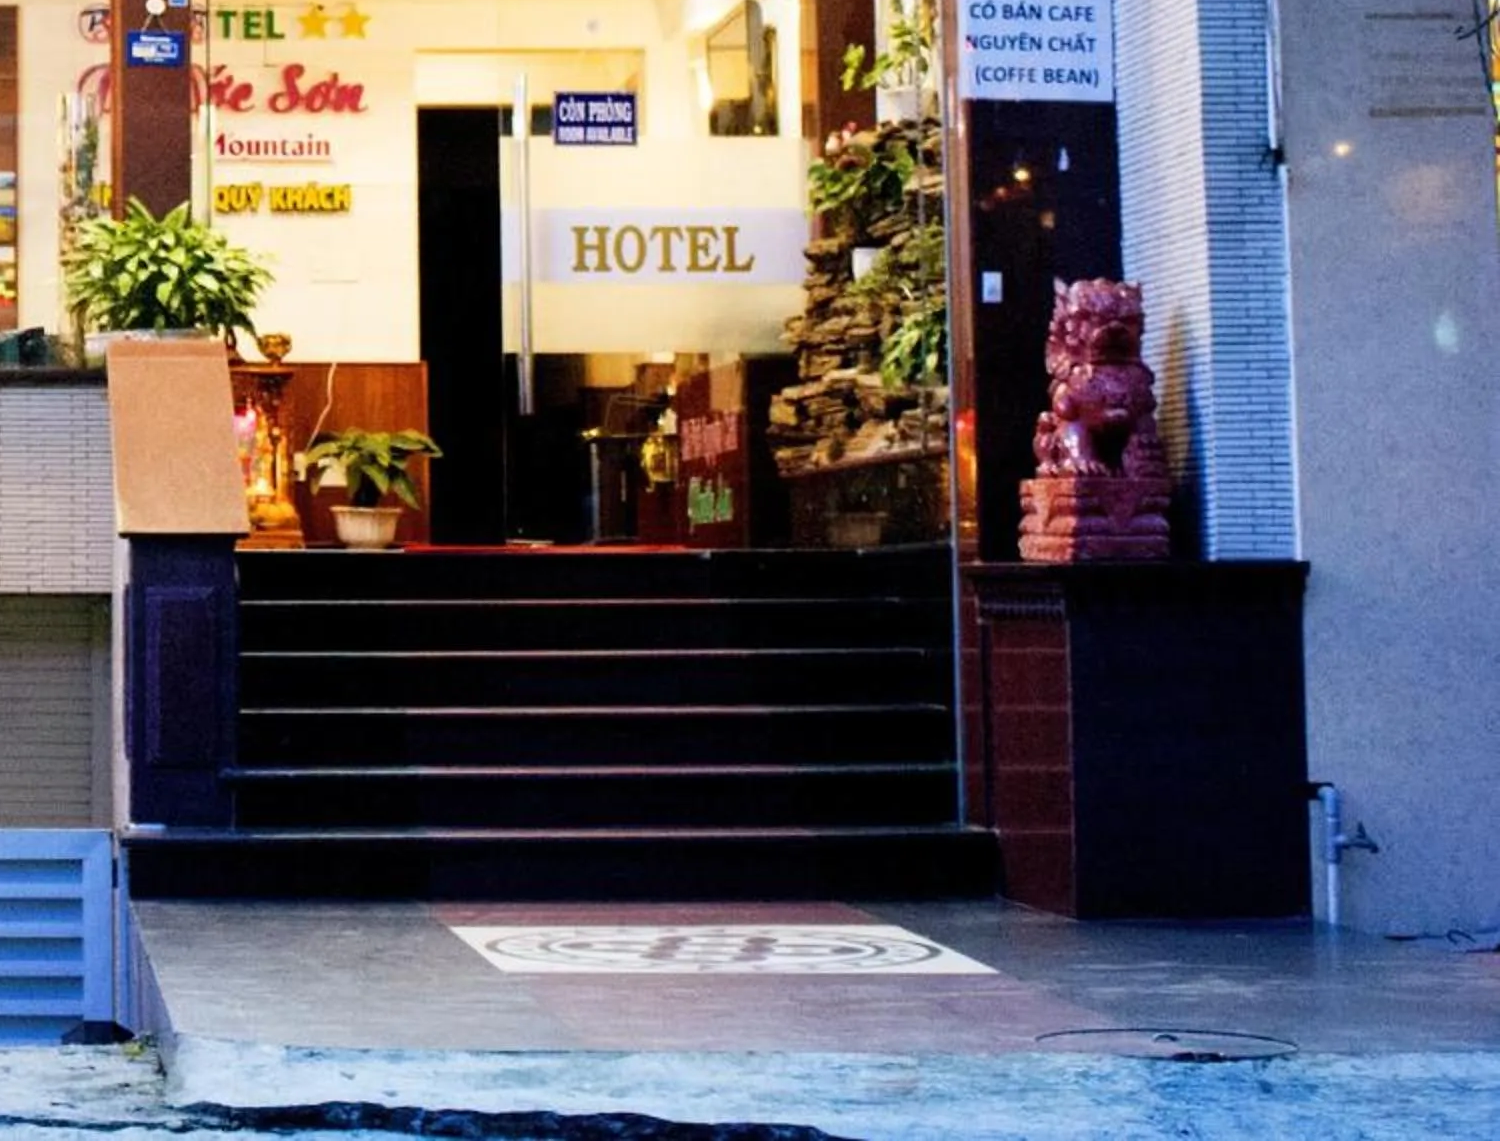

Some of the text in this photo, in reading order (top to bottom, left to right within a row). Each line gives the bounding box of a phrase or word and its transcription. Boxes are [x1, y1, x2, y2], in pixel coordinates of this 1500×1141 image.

[216, 9, 285, 40] TEL
[969, 0, 1095, 23] CÓ BÁN CAFE
[975, 65, 1099, 89] (COFFE BEAN)
[572, 226, 755, 273] HOTEL
